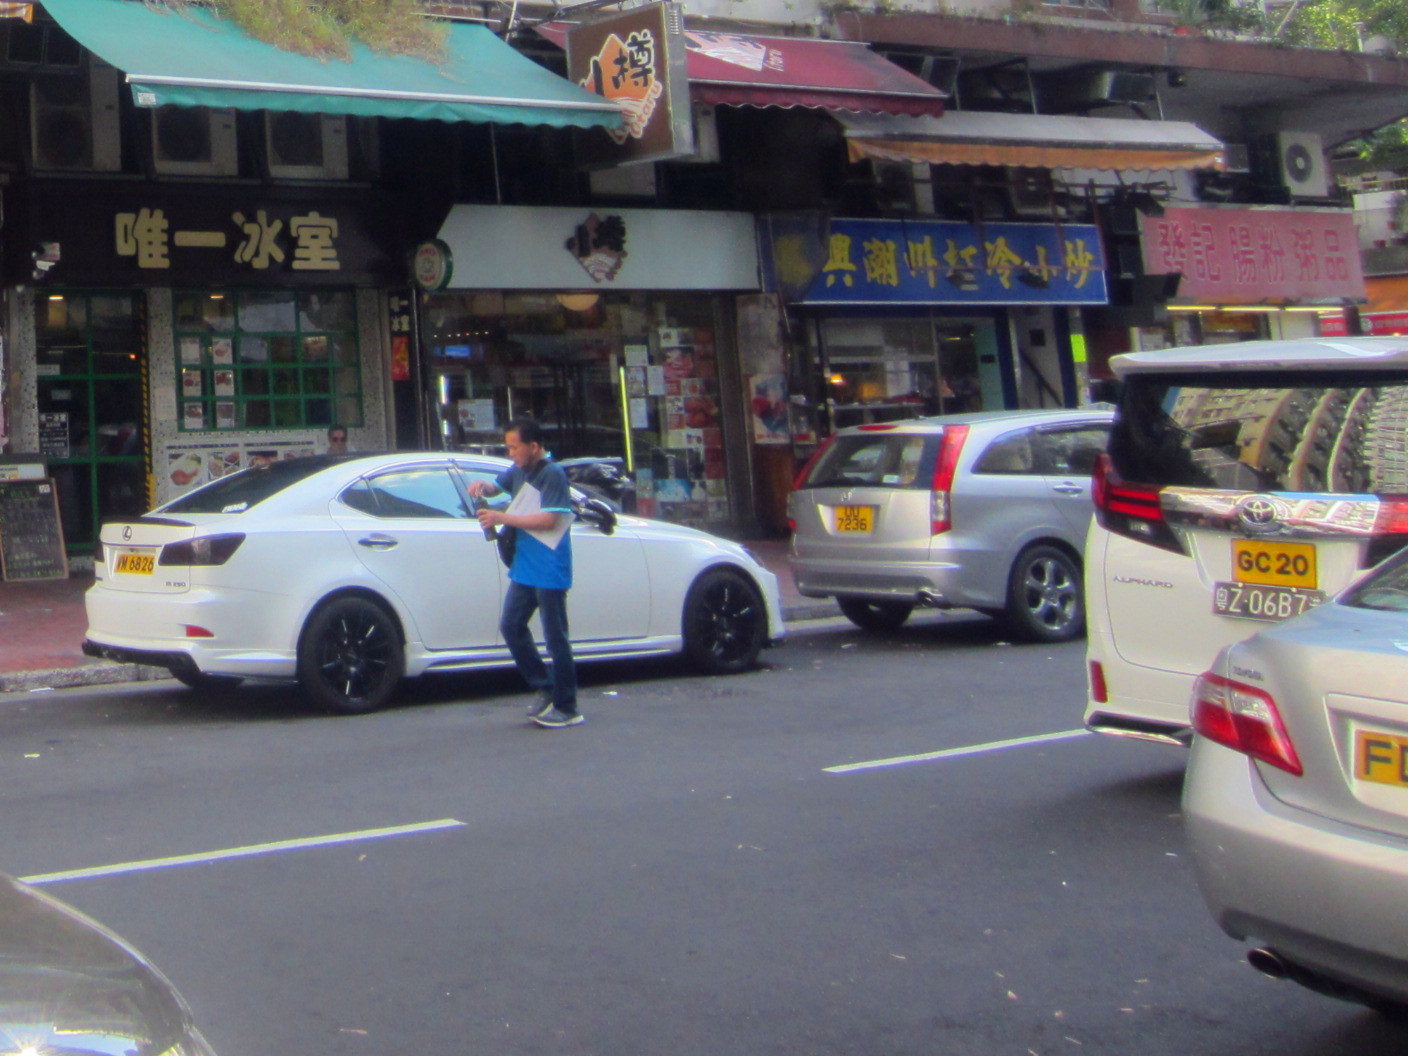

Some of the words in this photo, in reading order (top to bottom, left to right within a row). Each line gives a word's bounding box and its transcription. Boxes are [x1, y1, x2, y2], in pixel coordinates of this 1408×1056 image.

[115, 208, 340, 270] 唯一冰室
[838, 519, 867, 531] 7236
[130, 556, 154, 572] 6826
[1238, 551, 1271, 573] GC
[1275, 553, 1308, 576] 20
